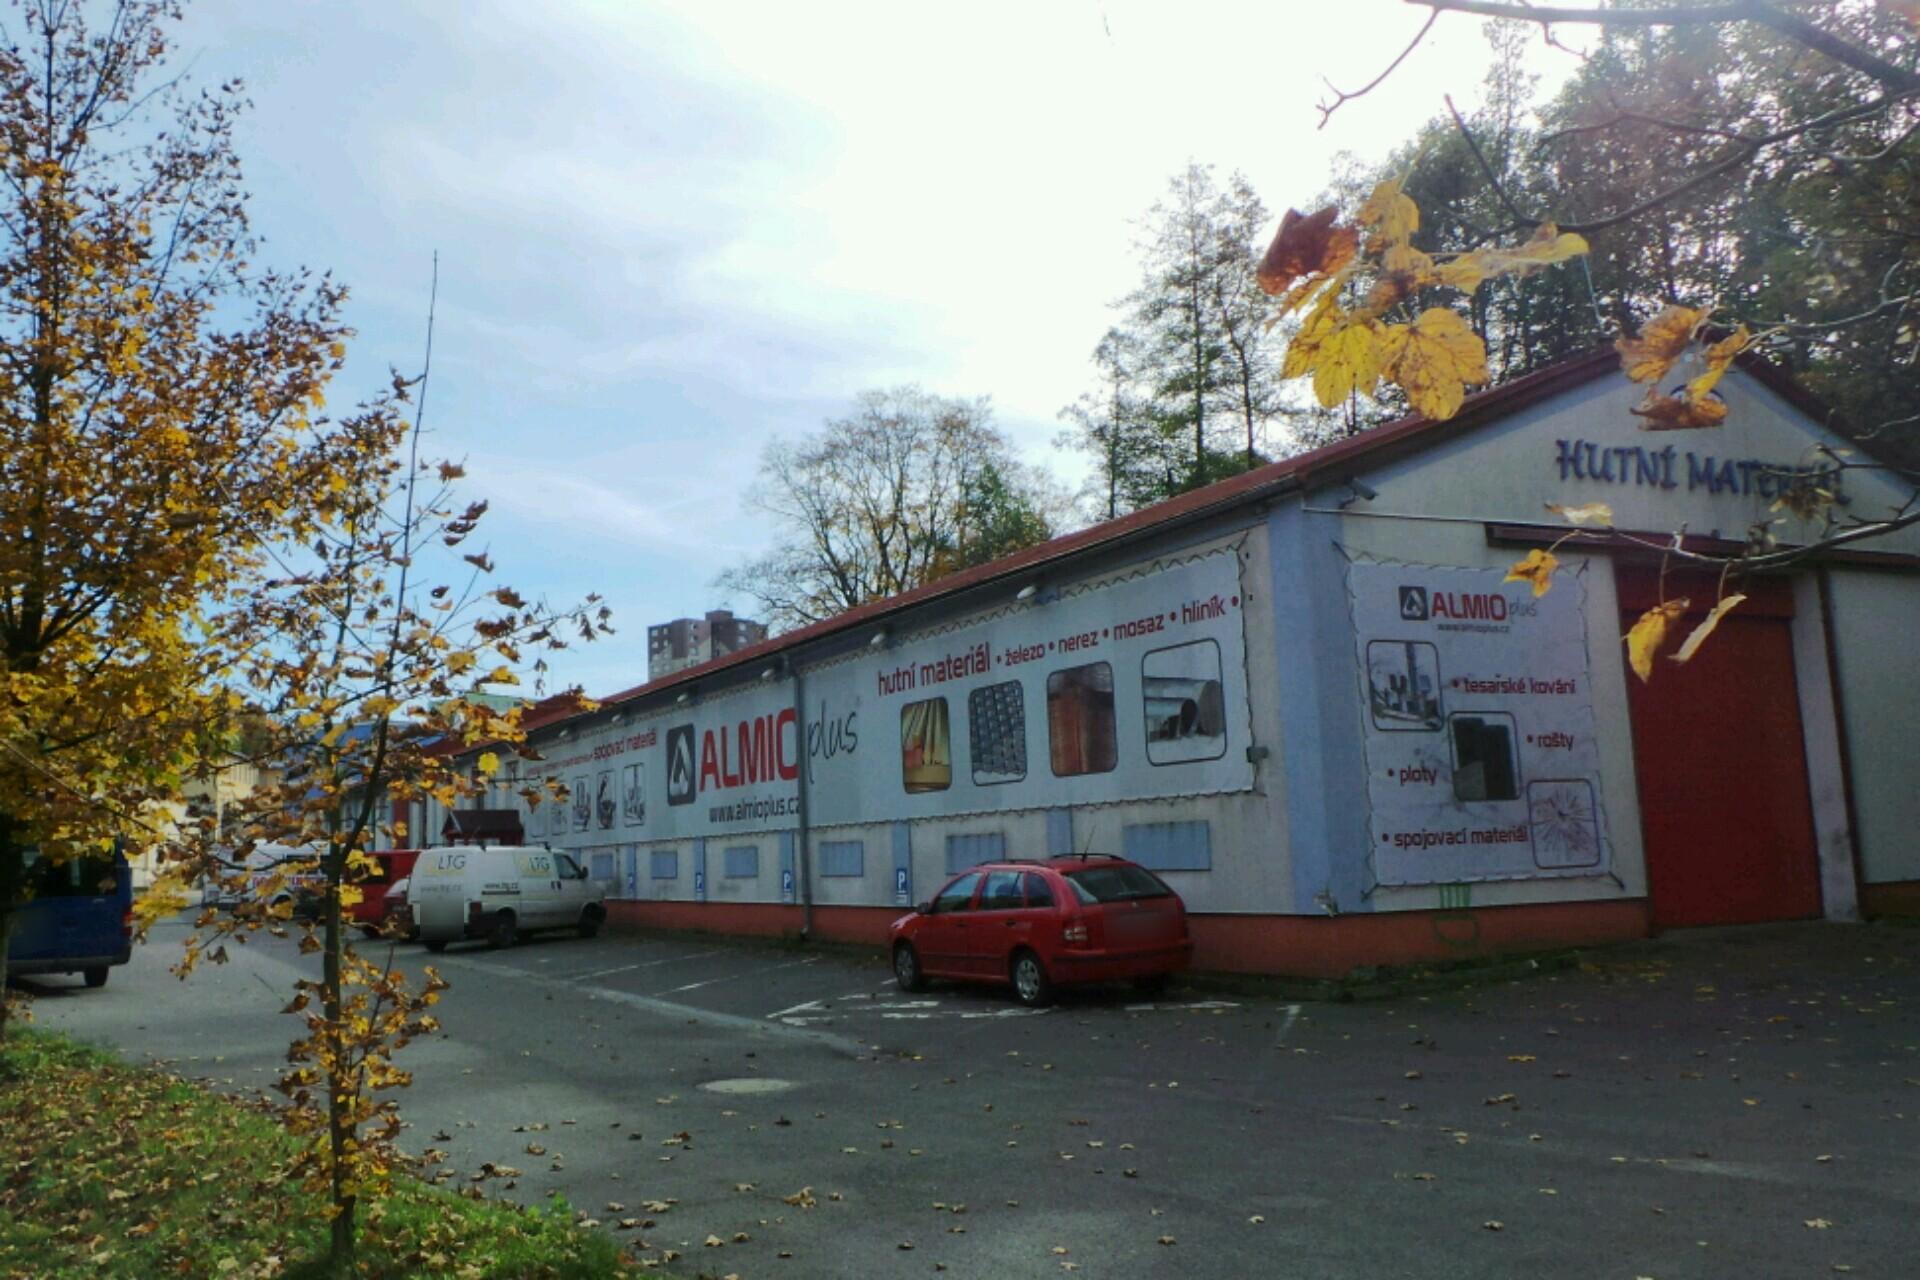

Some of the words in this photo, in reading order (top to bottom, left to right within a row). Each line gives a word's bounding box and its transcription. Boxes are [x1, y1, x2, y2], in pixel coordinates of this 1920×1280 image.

[1556, 438, 1678, 490] HUTNÍ
[1431, 592, 1507, 621] ALMIO
[1509, 597, 1537, 624] plus
[878, 662, 916, 696] hutní
[920, 641, 990, 687] materiál
[1005, 644, 1045, 666] železo
[1058, 630, 1099, 654] nerez
[1113, 613, 1165, 641] mosaz
[1182, 594, 1226, 625] hliník
[1463, 672, 1526, 694] tesařské
[1529, 676, 1576, 694] kování
[807, 700, 859, 785] plus
[1537, 732, 1574, 751] rošty
[1400, 762, 1436, 786] ploty
[1394, 827, 1467, 850] spojovací
[1471, 825, 1529, 844] materiál
[438, 855, 466, 870] LTG
[898, 870, 906, 889] P
